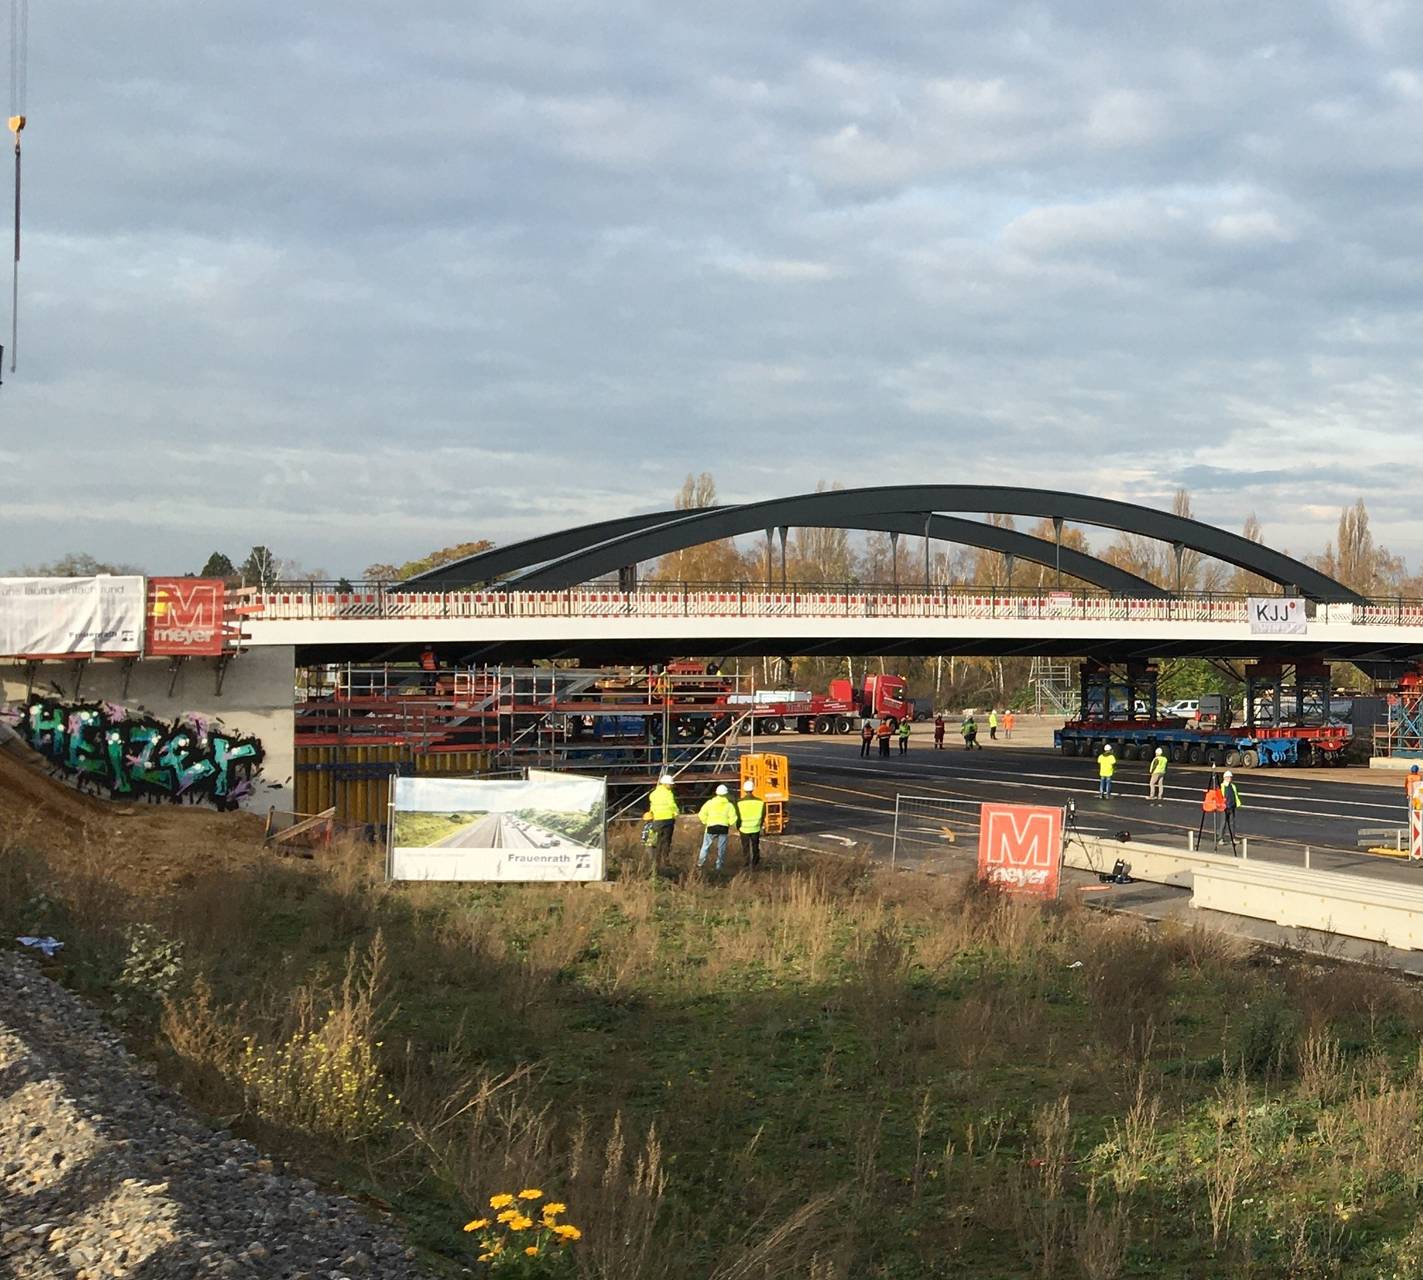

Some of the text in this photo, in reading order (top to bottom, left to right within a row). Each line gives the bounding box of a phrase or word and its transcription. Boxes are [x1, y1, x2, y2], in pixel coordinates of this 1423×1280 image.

[154, 584, 216, 627] M
[1256, 604, 1289, 622] KJJ
[154, 629, 215, 645] meyer
[987, 812, 1053, 867] M
[508, 854, 571, 863] Frauenrath
